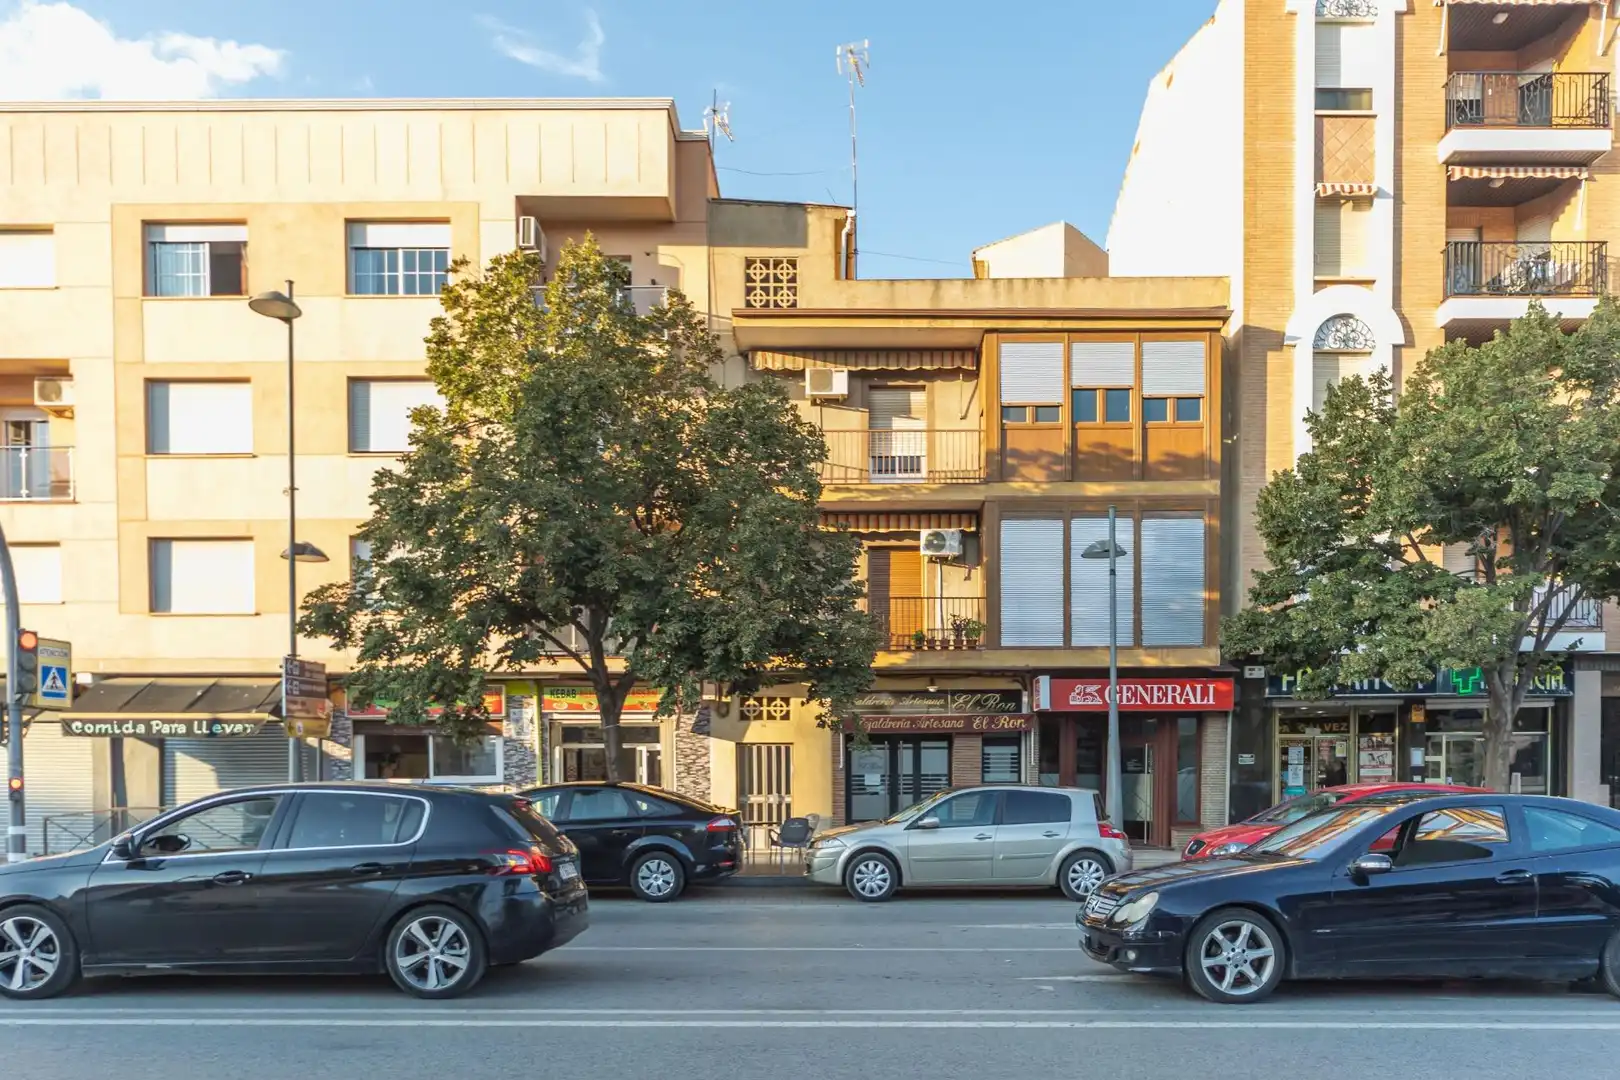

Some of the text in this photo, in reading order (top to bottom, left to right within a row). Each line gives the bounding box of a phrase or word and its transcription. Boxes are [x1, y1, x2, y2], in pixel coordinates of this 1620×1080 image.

[951, 693, 980, 712] El
[977, 693, 1017, 712] Ron
[1104, 684, 1216, 705] GENERALI
[71, 719, 146, 735] Comida
[150, 719, 187, 735] Para
[912, 715, 964, 730] Artesana
[972, 715, 1028, 730] El Ron
